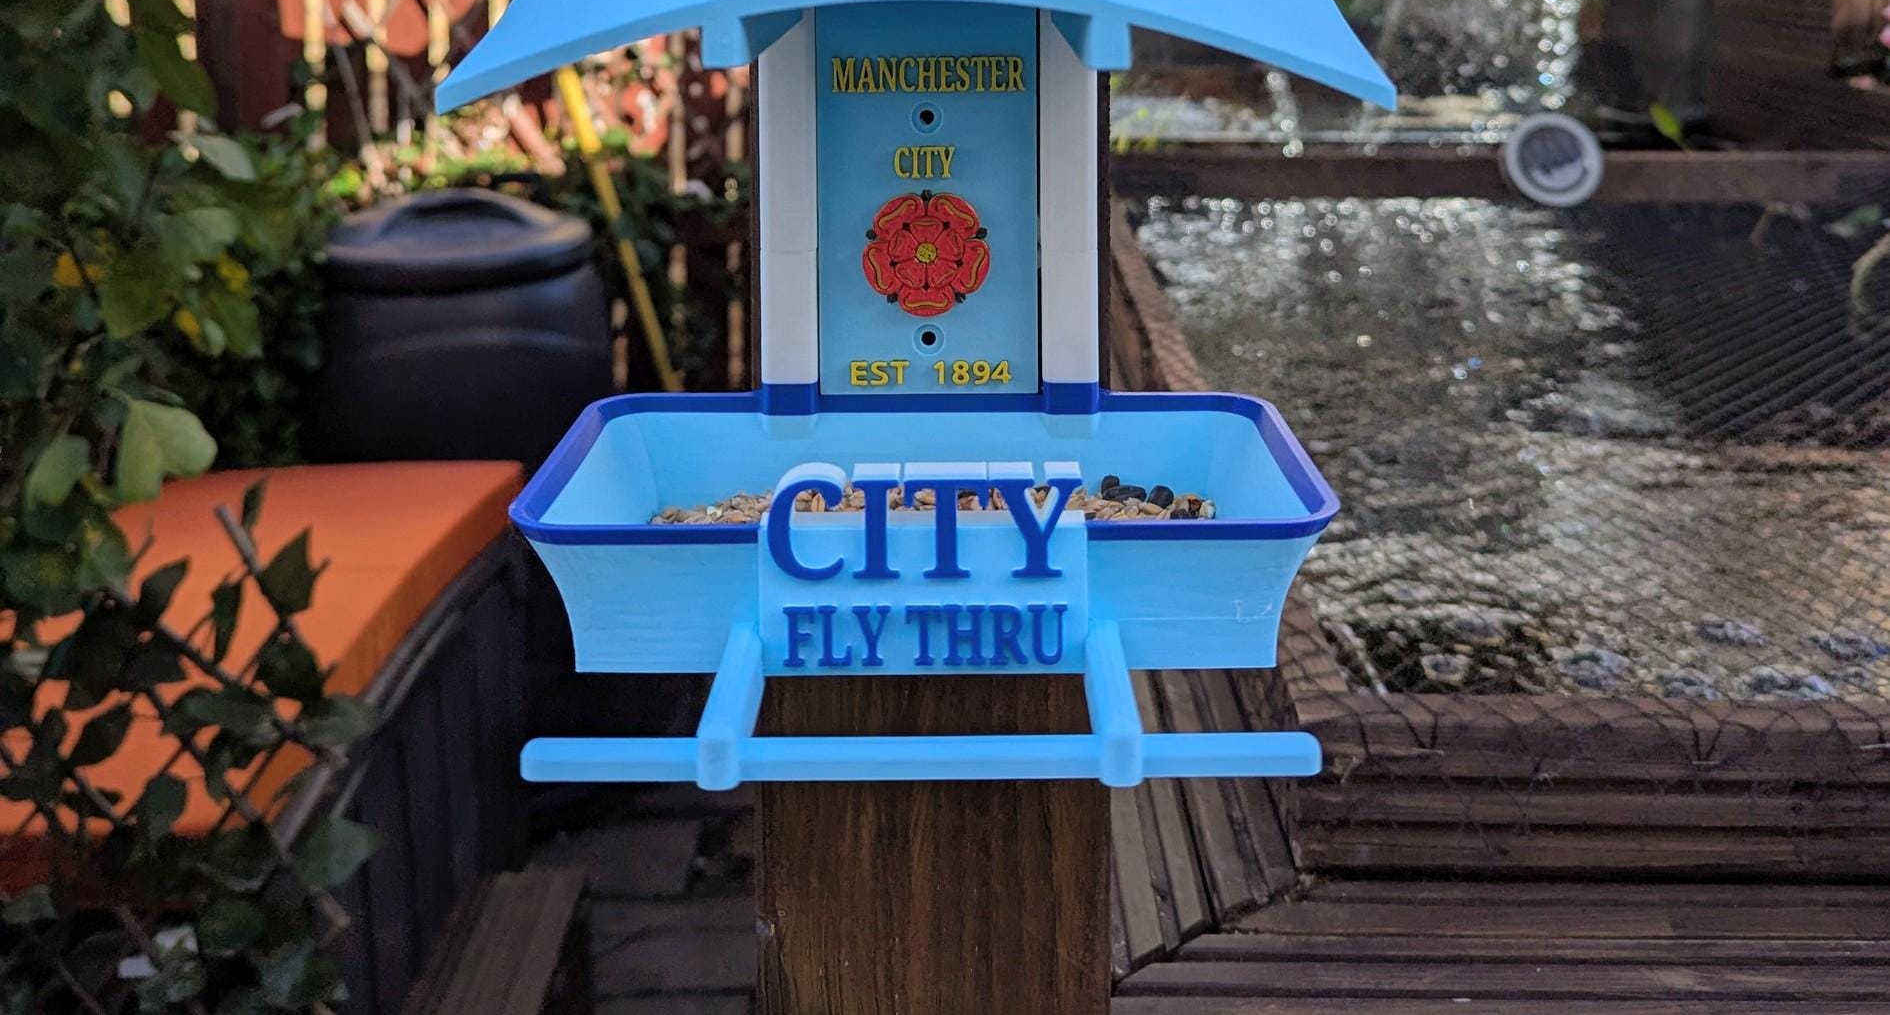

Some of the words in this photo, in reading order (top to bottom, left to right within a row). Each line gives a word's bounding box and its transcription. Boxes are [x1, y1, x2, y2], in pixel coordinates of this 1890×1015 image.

[831, 56, 1025, 93] MANCHESTER
[893, 145, 955, 179] CITY
[850, 360, 910, 386] EST
[933, 360, 1012, 385] 1894
[767, 473, 1082, 580] CITY
[782, 604, 892, 667] FLY
[904, 603, 1068, 666] THRU
